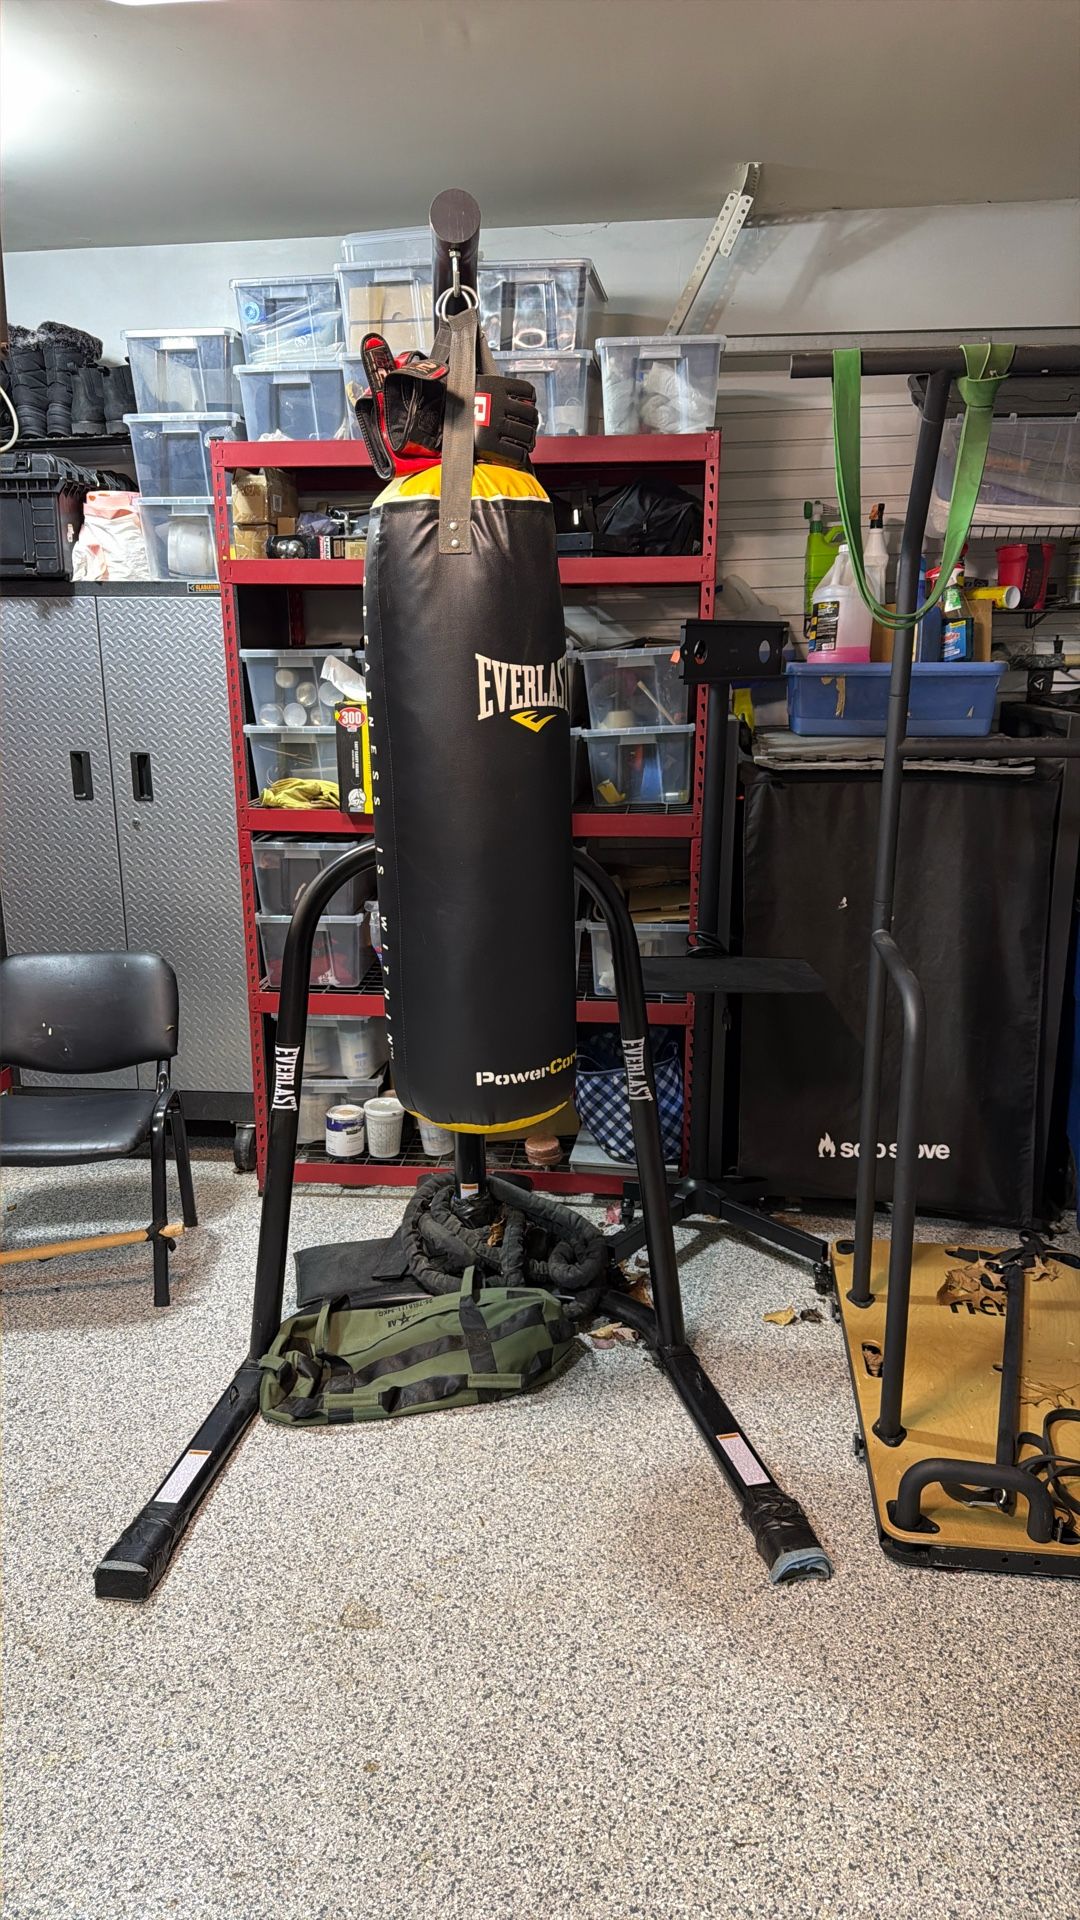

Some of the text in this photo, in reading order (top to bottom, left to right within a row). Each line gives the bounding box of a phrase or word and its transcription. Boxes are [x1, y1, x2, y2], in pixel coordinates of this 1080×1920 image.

[342, 711, 362, 725] 300
[271, 1045, 301, 1112] EVERLAST
[475, 1048, 577, 1087] PowerCor
[621, 1036, 654, 1102] EVERLAST
